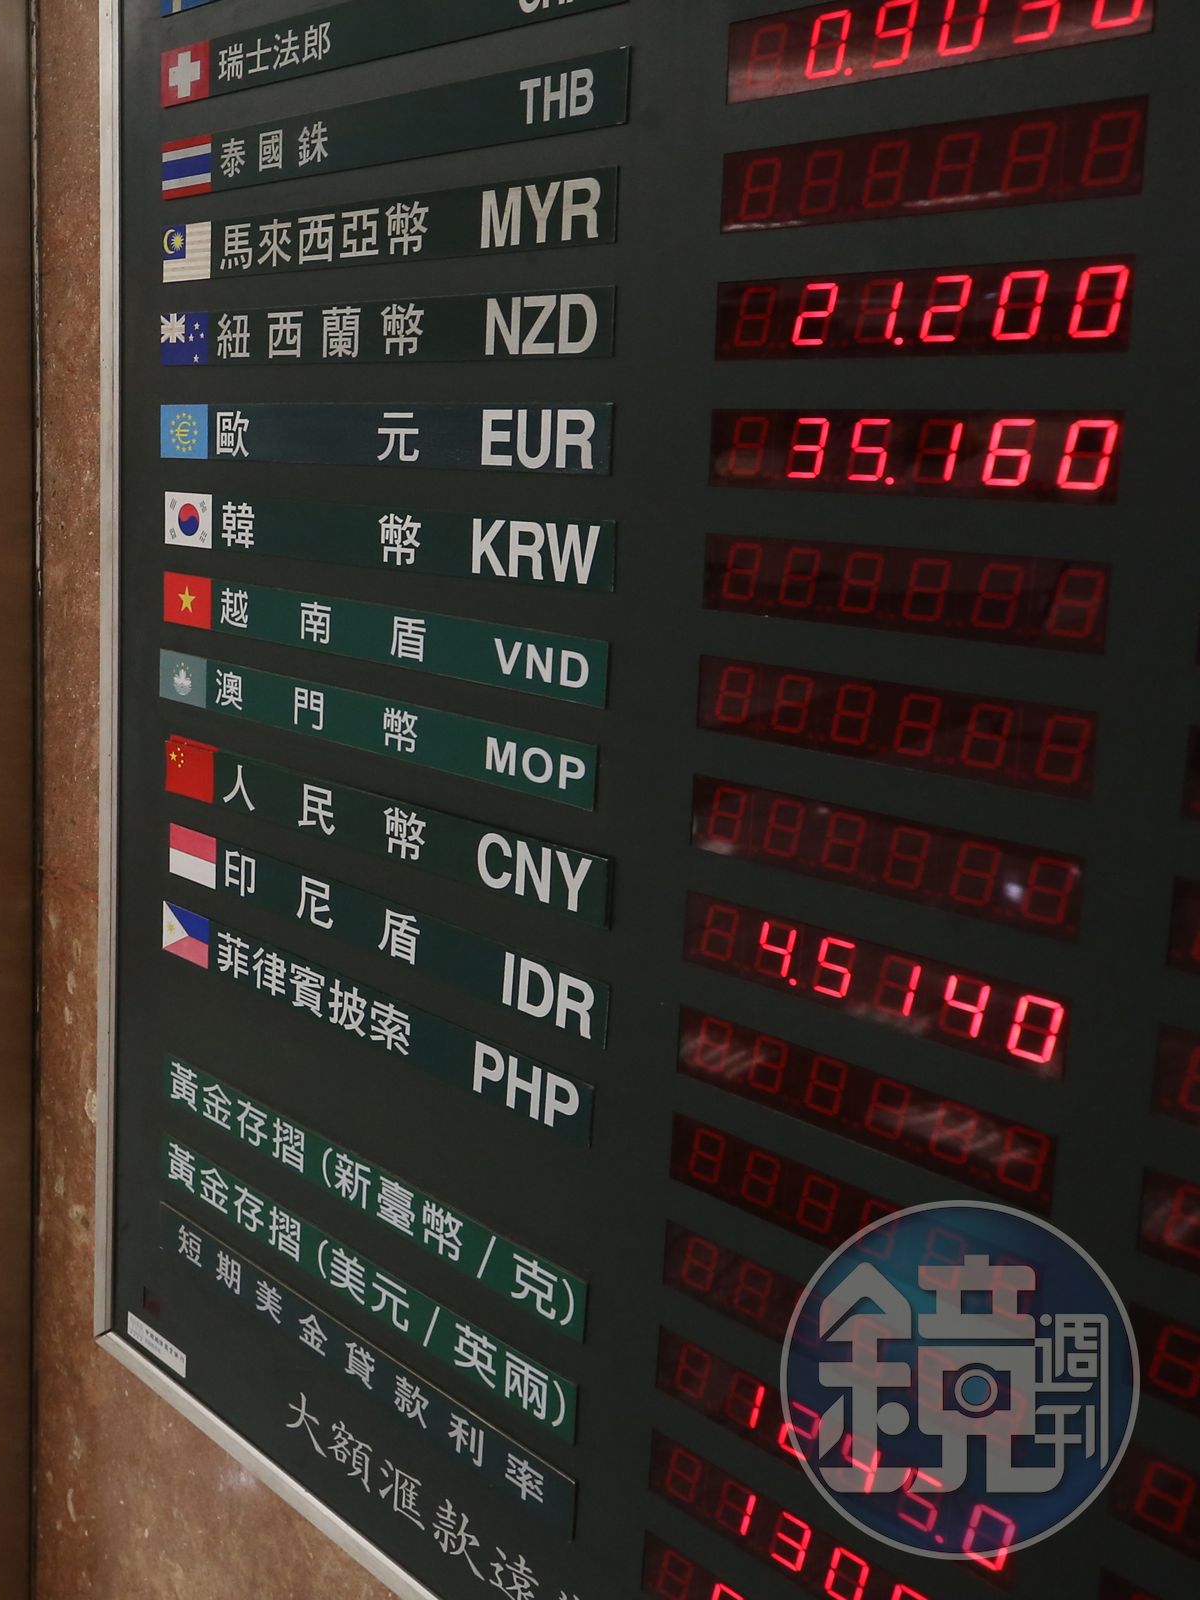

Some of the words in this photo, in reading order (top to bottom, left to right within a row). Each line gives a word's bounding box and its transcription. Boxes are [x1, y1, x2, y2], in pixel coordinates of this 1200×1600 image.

[218, 21, 332, 82] 瑞士法郎
[220, 121, 329, 178] 泰國銖
[519, 68, 594, 125] THB
[220, 201, 429, 270] 馬來西亞幣
[480, 177, 601, 249] MYR
[217, 303, 425, 360] 紐西蘭幣
[485, 293, 598, 356] NZD
[791, 264, 1130, 347] 21.200
[481, 409, 596, 470] EUR
[787, 417, 1119, 491] 35.160
[471, 518, 601, 585] KRW
[494, 637, 589, 689] VND
[485, 736, 586, 791] MOP
[477, 832, 593, 913] CNY
[216, 931, 412, 1056] 菲律賓披索
[472, 1040, 580, 1128] PHP
[502, 951, 596, 1040] IDR
[759, 920, 1065, 1064] 4.5140
[286, 1391, 585, 1600] 大額匯款遠
[739, 1493, 930, 1600] 130
